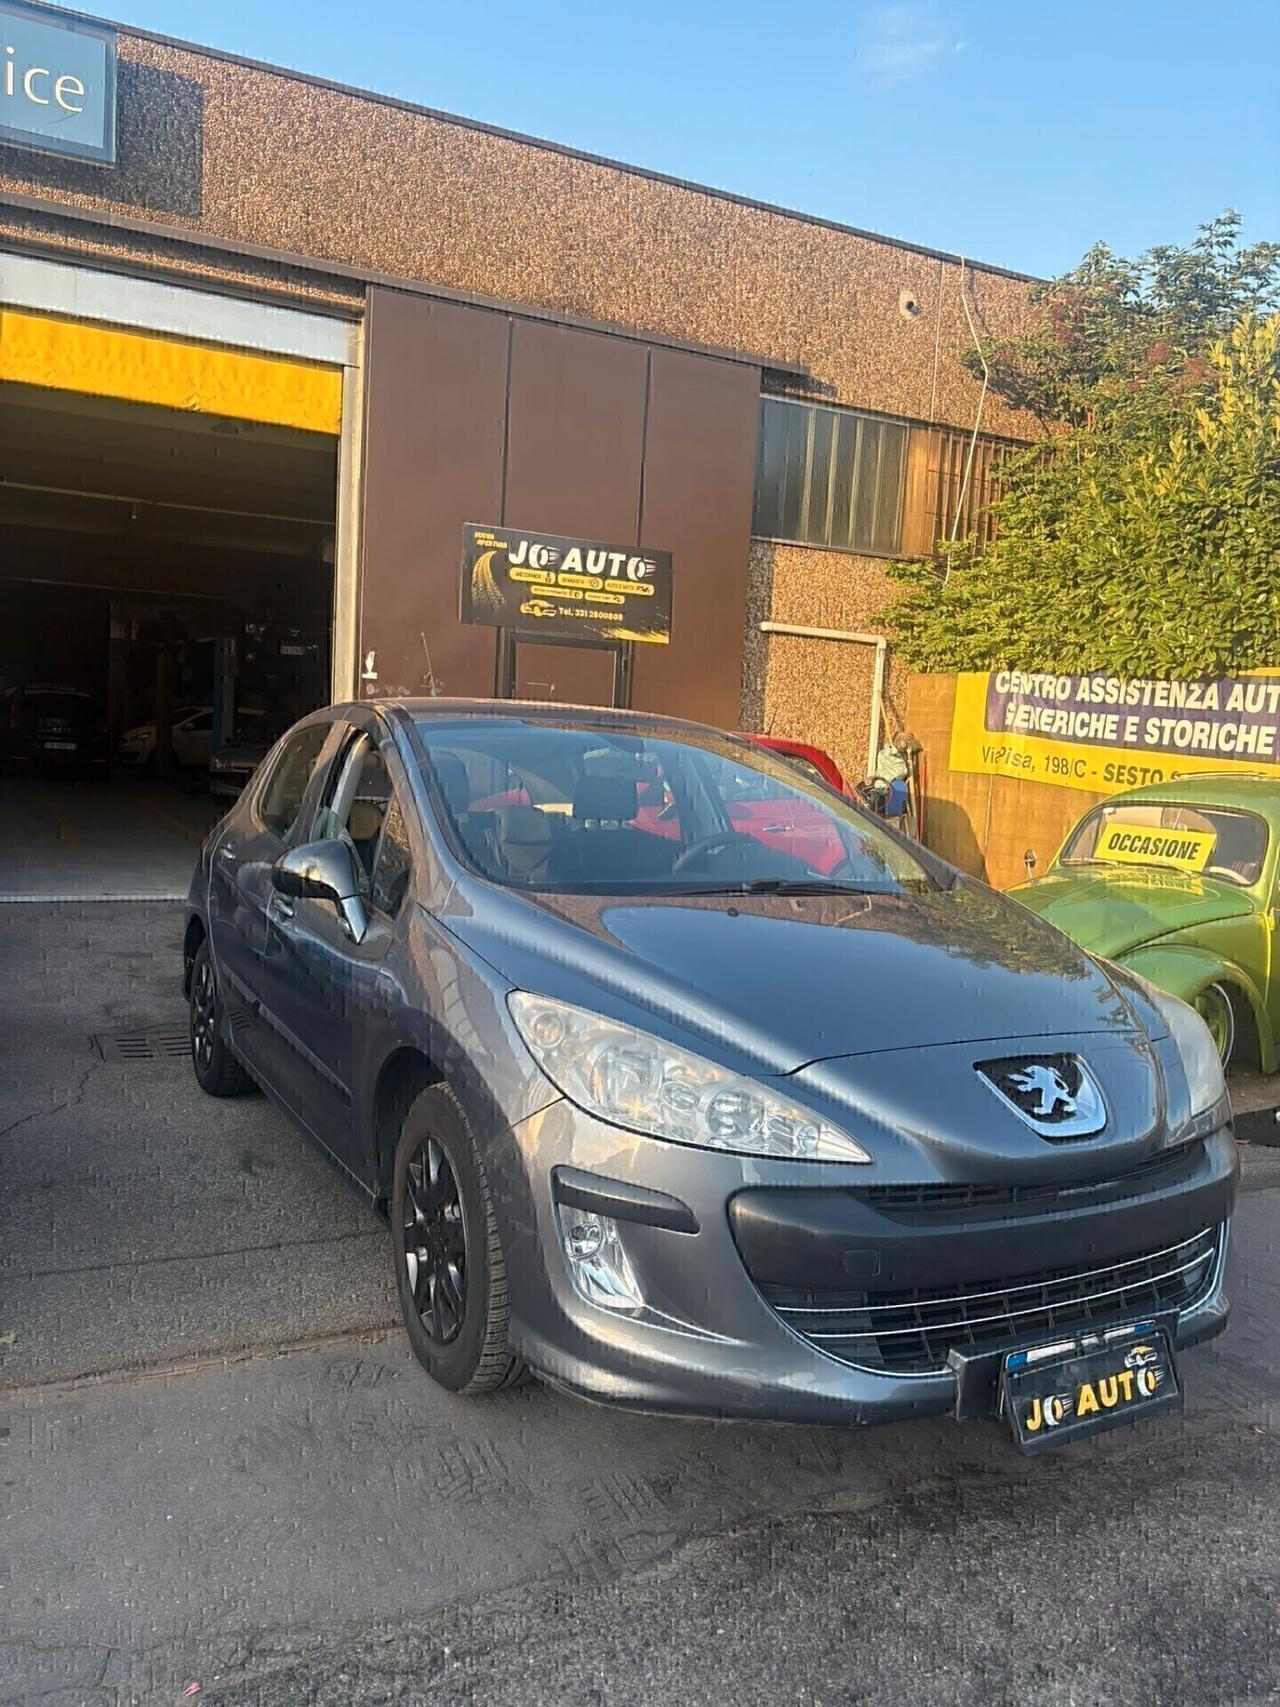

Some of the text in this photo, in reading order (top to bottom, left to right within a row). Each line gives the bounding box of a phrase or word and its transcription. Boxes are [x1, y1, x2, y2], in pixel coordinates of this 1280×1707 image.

[508, 540, 649, 581] JO AUTO
[558, 607, 574, 616] Tel.
[995, 671, 1280, 714] CENTRO ASSISTENZA AUT
[1124, 716, 1140, 743] E
[1144, 718, 1275, 755] STORICHE
[1044, 755, 1087, 778] 198/C
[1103, 763, 1163, 786] SESTO
[1107, 832, 1202, 861] OCCASIONE
[1026, 1366, 1158, 1432] JO AUTO
